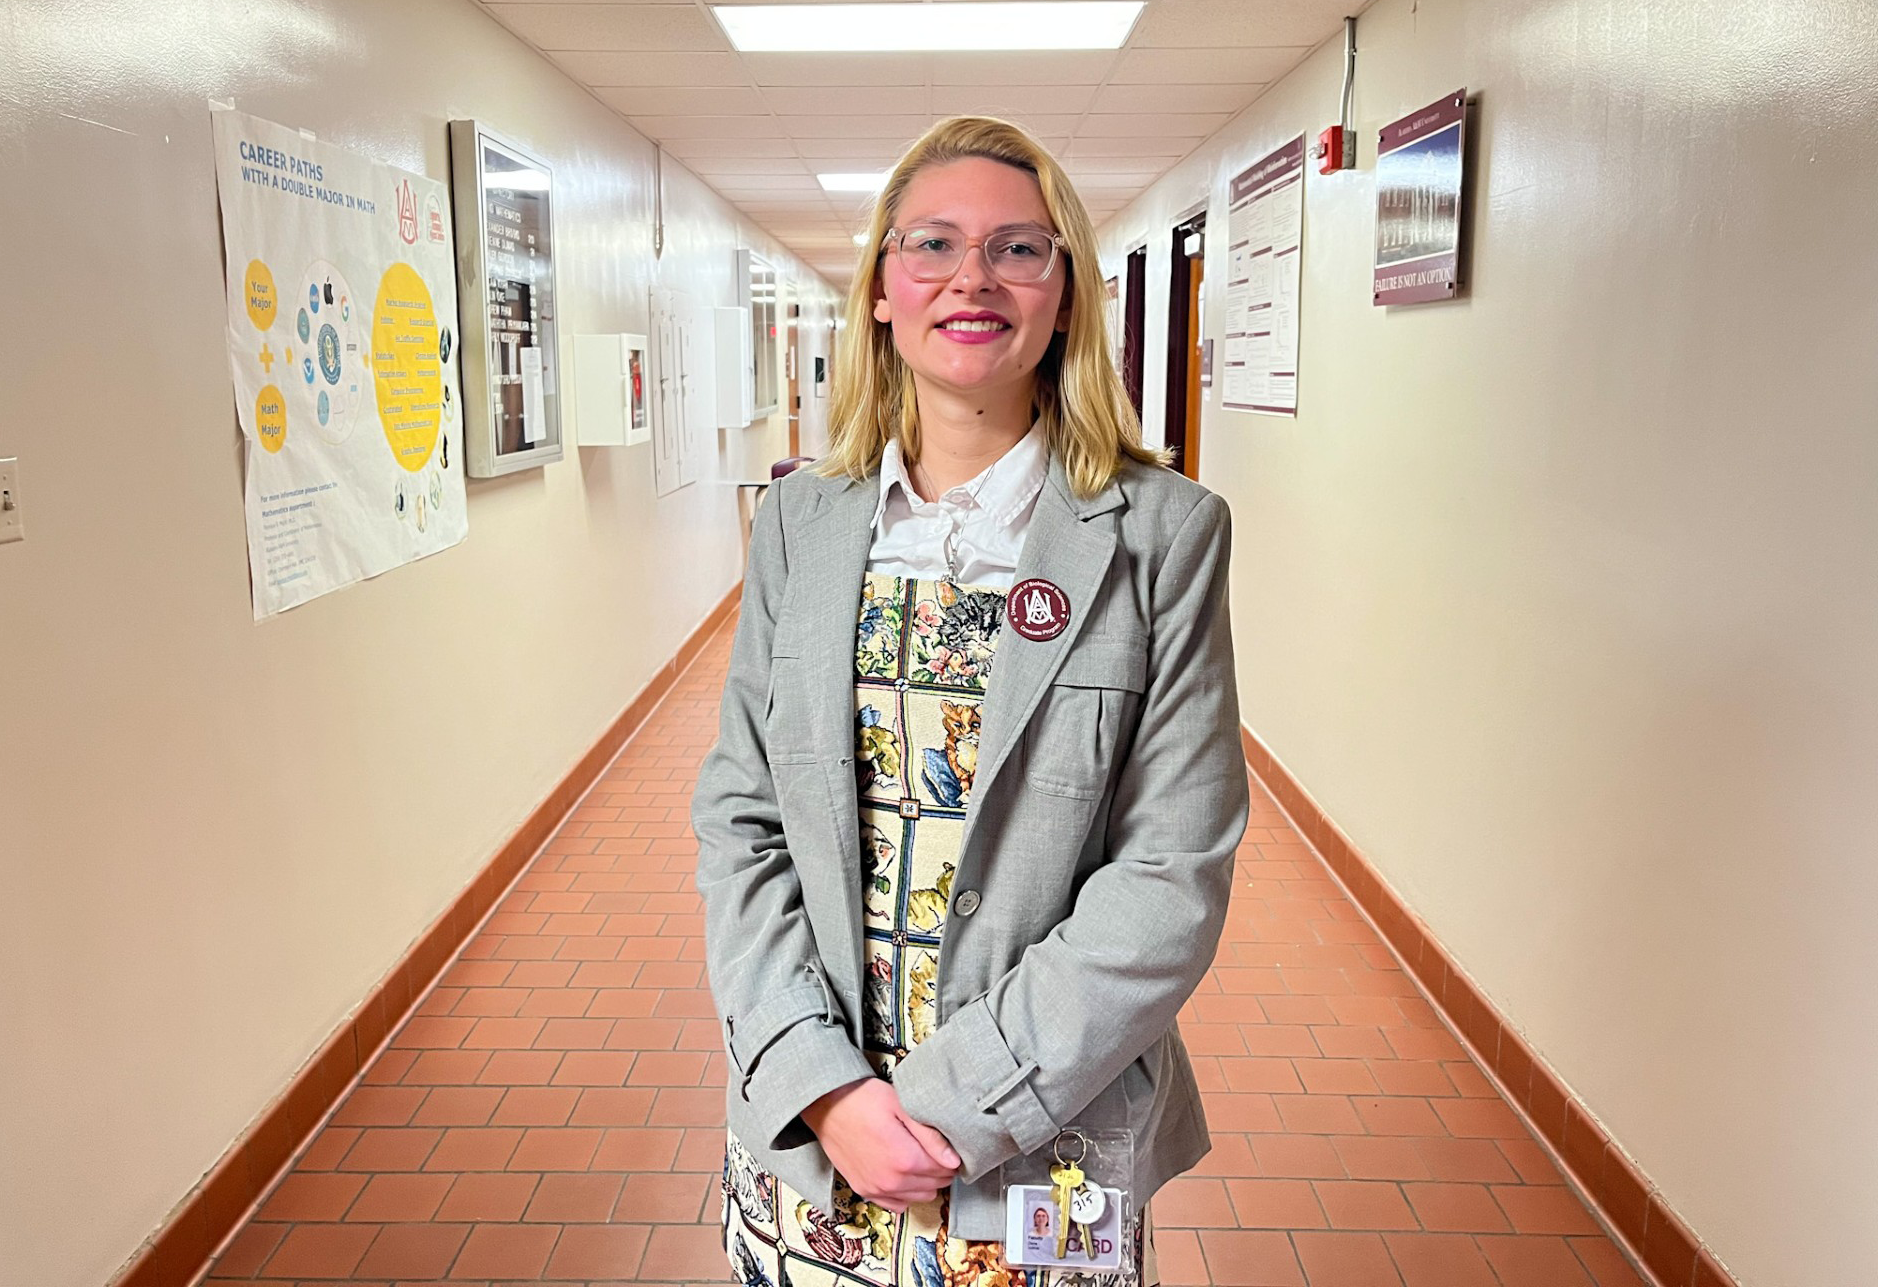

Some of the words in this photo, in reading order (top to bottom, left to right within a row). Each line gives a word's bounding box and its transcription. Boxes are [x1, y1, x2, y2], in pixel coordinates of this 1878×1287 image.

[239, 141, 287, 172] CAREER
[290, 156, 323, 182] PATHS
[241, 165, 269, 187] WITH
[272, 174, 279, 189] A
[281, 177, 314, 199] DOUBLE
[316, 187, 344, 207] MAJOR
[345, 194, 355, 209] IN
[356, 197, 376, 214] MATH
[251, 280, 268, 293] Your
[1374, 276, 1398, 293] FAILURE
[1397, 274, 1404, 289] IS
[1403, 272, 1417, 288] NOT
[1416, 270, 1427, 286] AN
[1426, 266, 1453, 284] OPTION
[251, 296, 272, 311] Major
[261, 402, 279, 415] Math
[261, 423, 281, 437] Major
[280, 488, 304, 499] information
[304, 486, 318, 495] please
[262, 507, 288, 518] Mathematics
[1029, 581, 1055, 591] Biological
[1020, 624, 1043, 636] Graduate
[1042, 622, 1061, 635] Program
